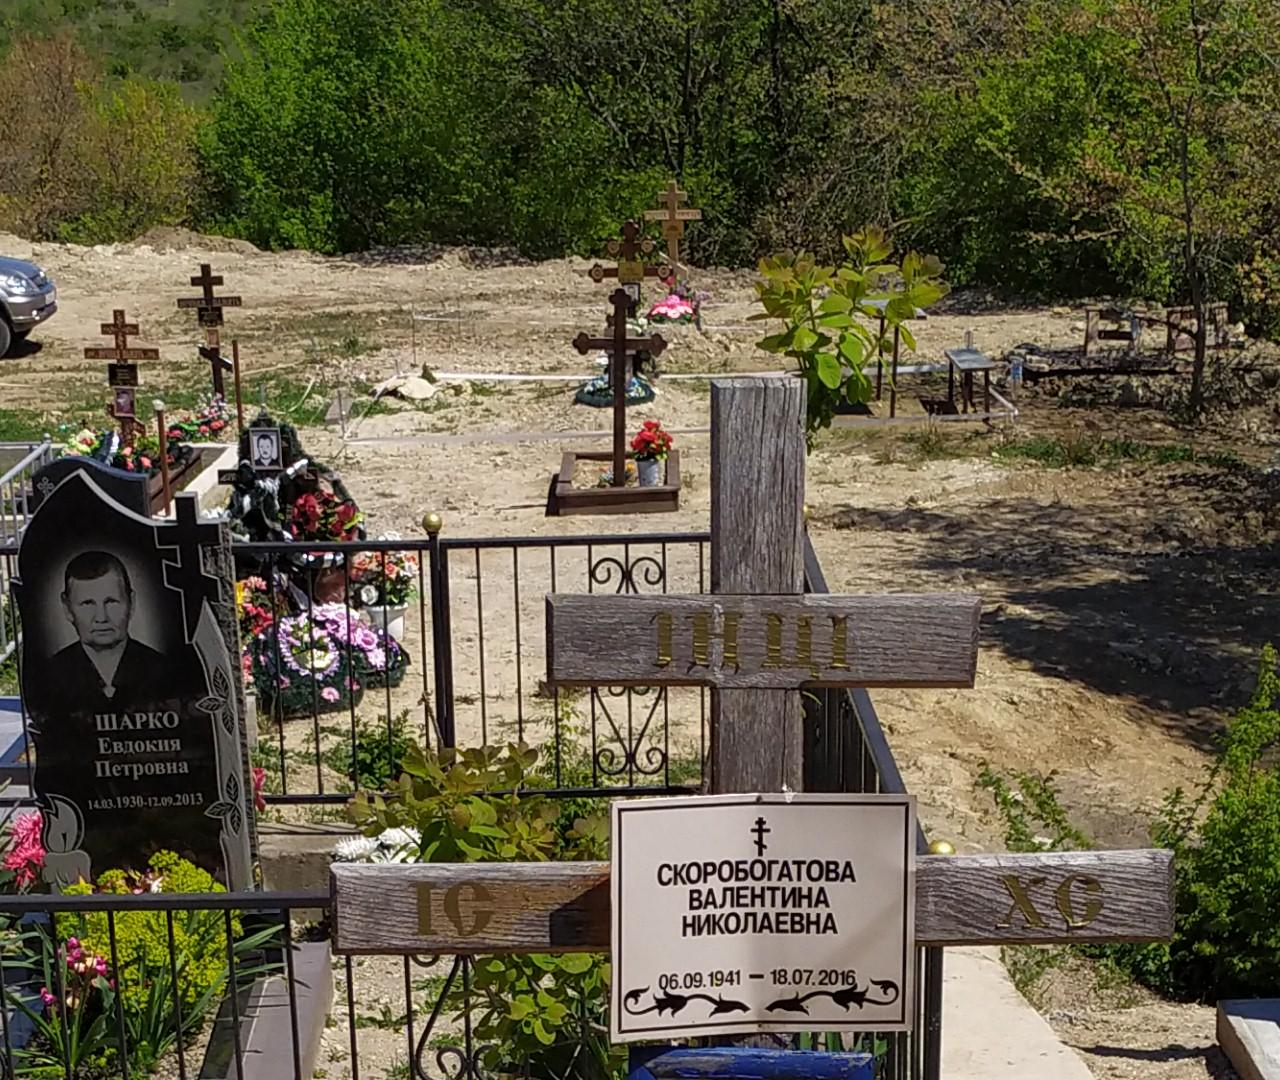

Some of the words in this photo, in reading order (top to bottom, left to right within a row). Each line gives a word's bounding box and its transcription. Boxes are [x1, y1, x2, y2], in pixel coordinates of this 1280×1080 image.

[95, 711, 179, 731] ШАРКО
[98, 737, 181, 755] Евдокия
[94, 760, 189, 780] Петровна
[657, 859, 856, 887] СКОРОБОГАТОВА
[689, 886, 830, 911] ВАЛЕНТИНА
[682, 912, 838, 937] НИКОЛАЕВНА
[658, 969, 741, 990] 06.09.1941
[770, 969, 856, 986] 18.07.2016
